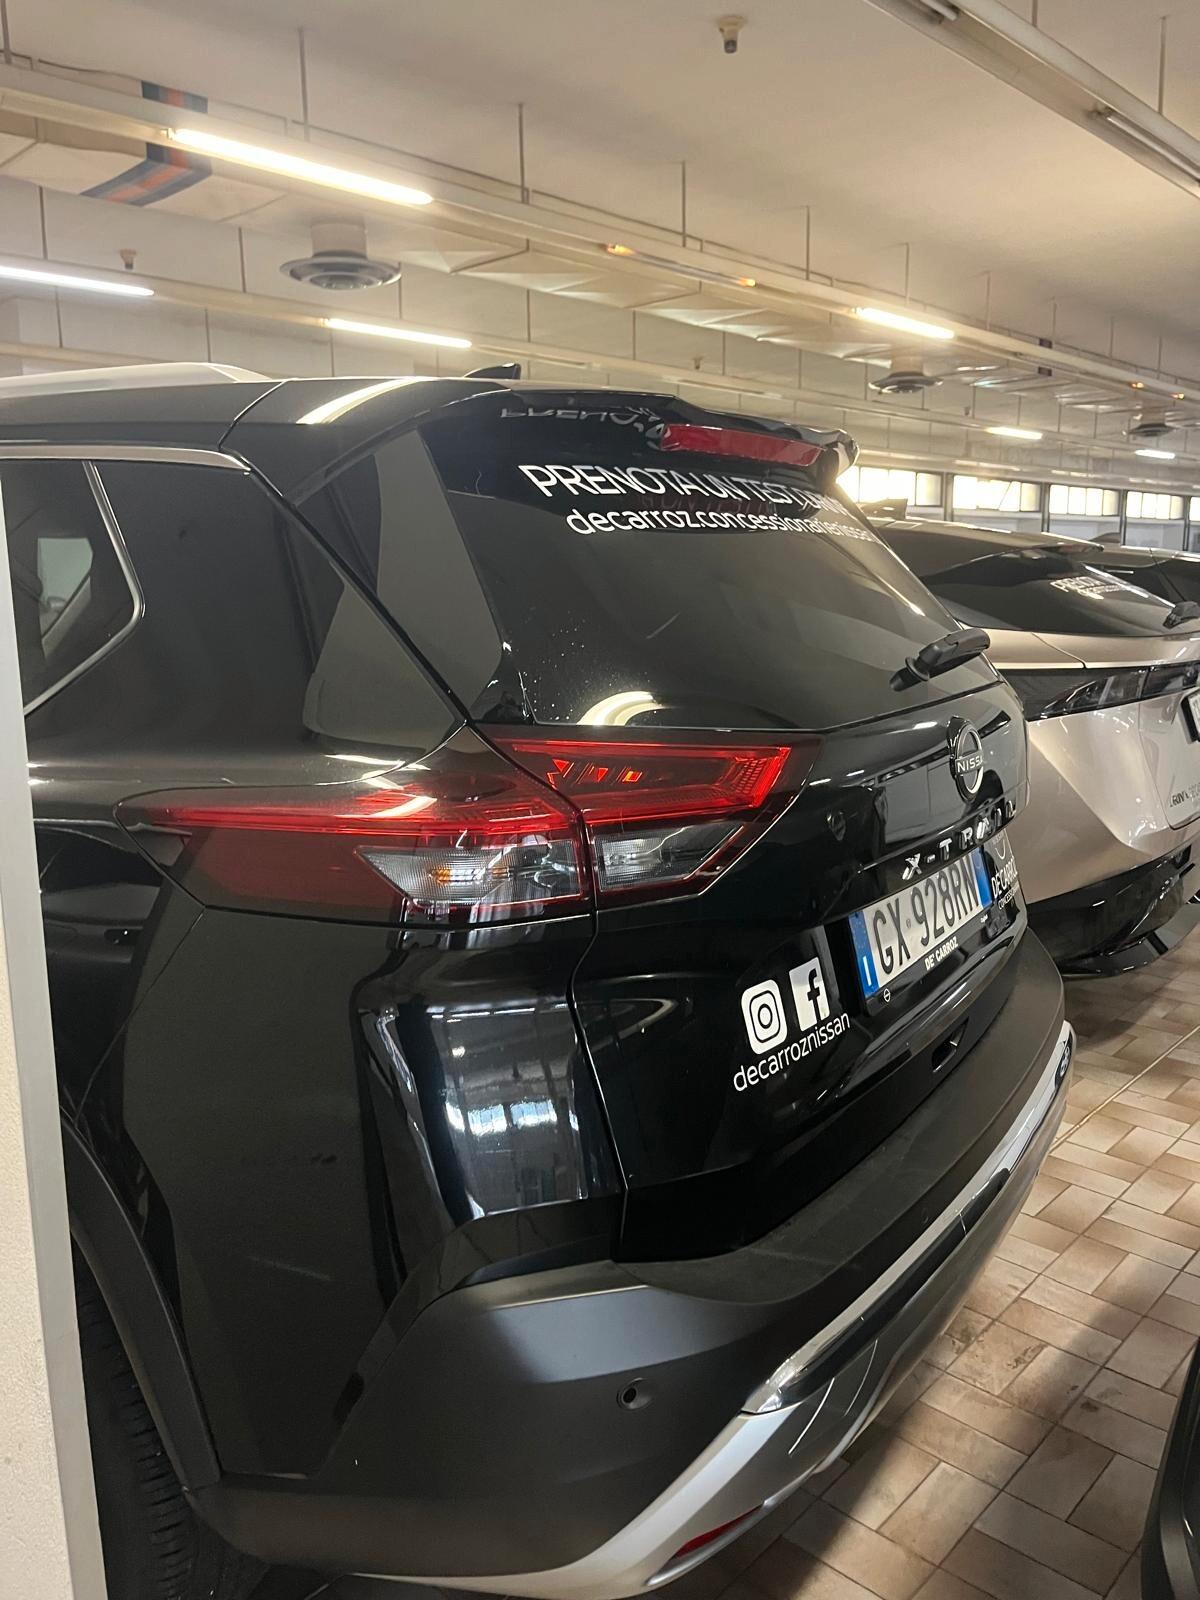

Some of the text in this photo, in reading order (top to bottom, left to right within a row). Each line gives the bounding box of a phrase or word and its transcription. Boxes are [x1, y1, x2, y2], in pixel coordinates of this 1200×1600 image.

[518, 465, 710, 497] PRENOTA
[689, 472, 751, 501] UN
[730, 476, 804, 506] TEST
[957, 756, 984, 773] NISS
[873, 897, 911, 975] GX
[910, 851, 980, 947] 928RN
[935, 935, 959, 963] CARROZ
[733, 1012, 851, 1092] decarroznissan
